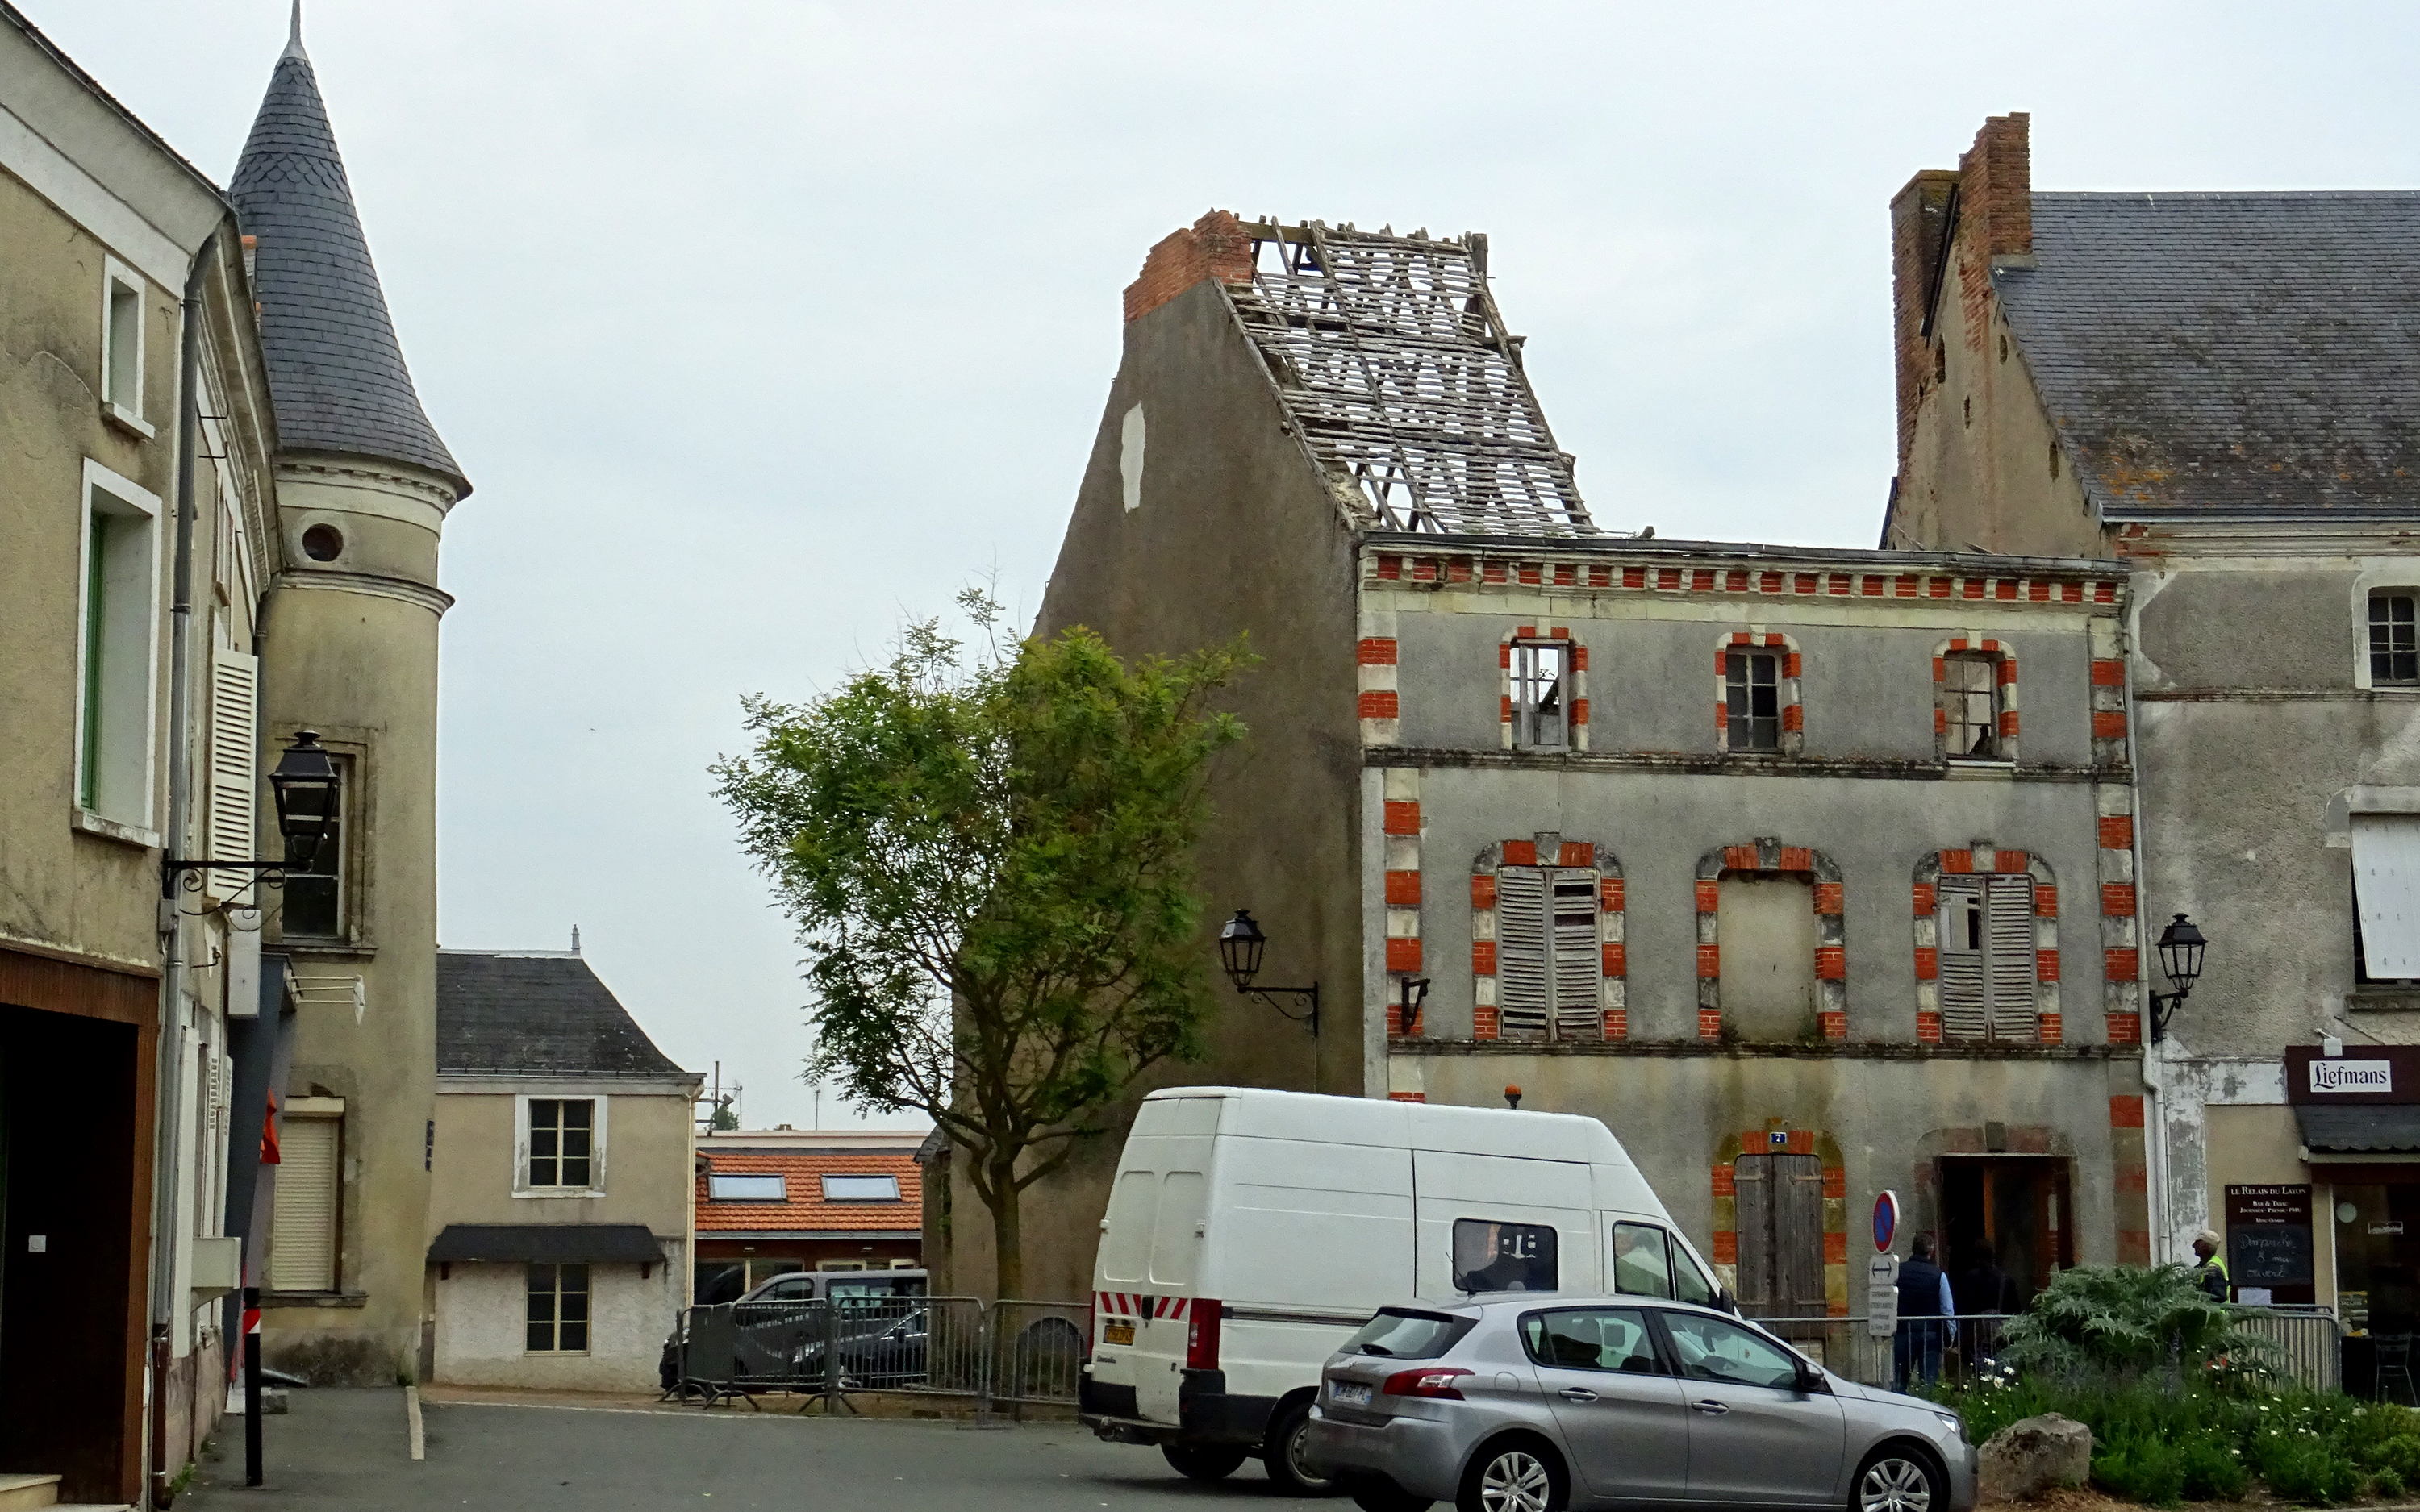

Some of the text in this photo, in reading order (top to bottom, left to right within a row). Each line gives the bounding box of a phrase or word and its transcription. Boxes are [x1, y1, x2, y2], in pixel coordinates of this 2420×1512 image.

[2314, 1062, 2387, 1089] Liefmans
[1775, 1134, 1781, 1143] 7
[2242, 1186, 2268, 1195] RELAIS
